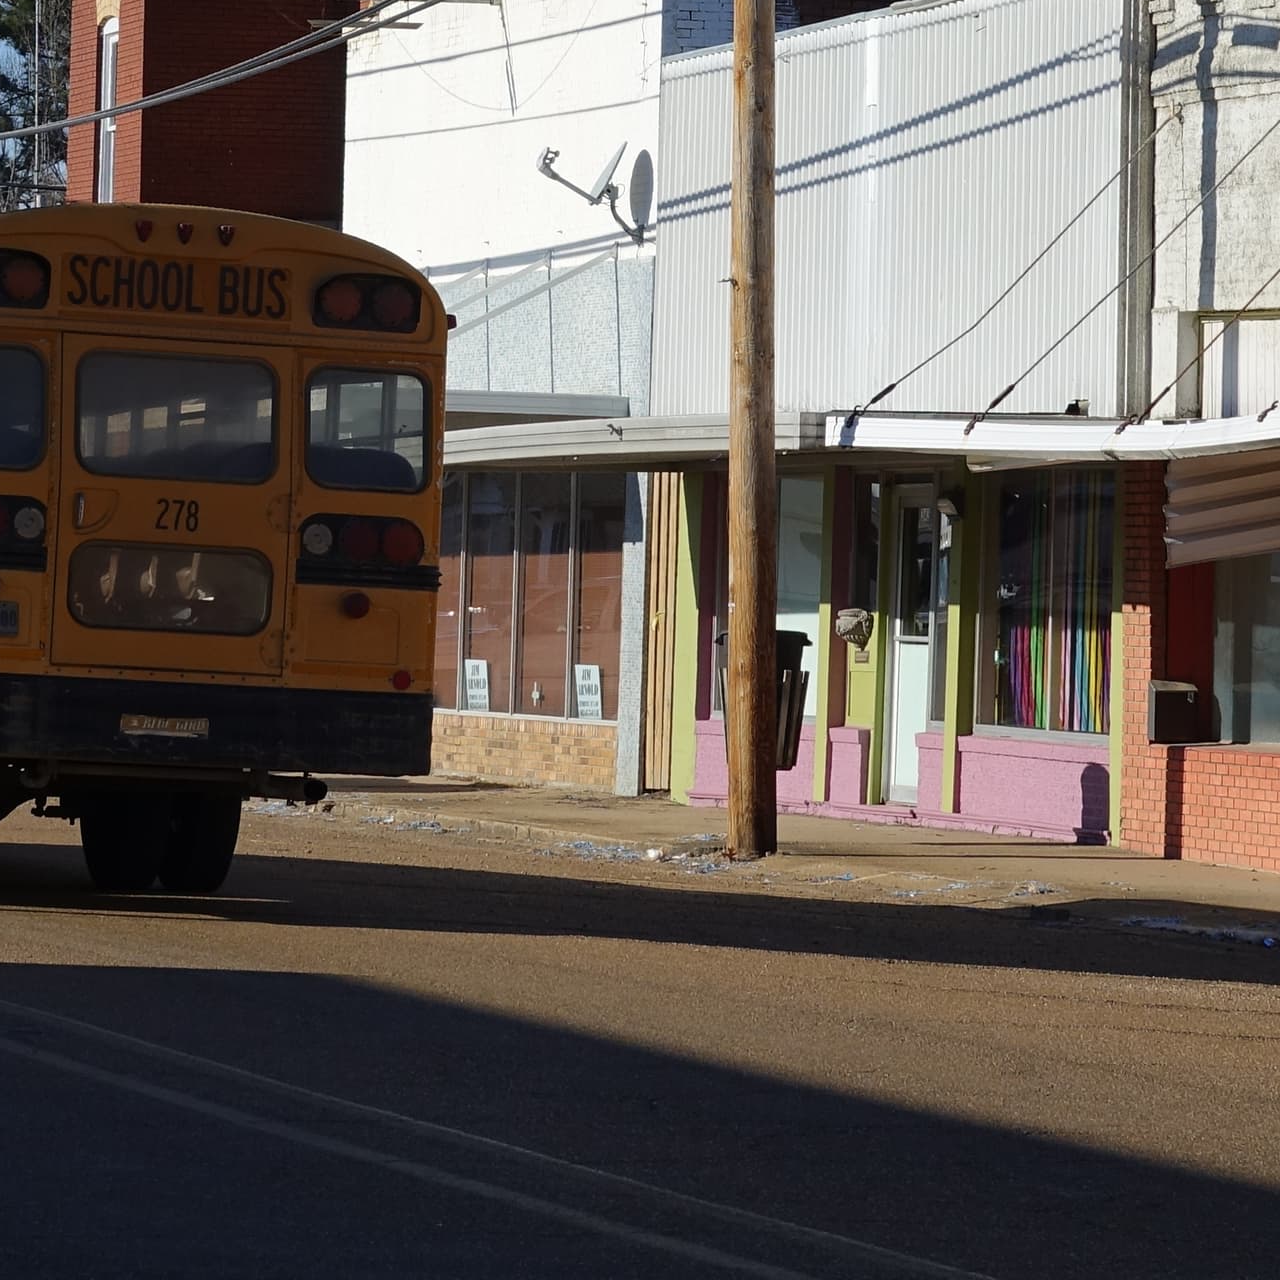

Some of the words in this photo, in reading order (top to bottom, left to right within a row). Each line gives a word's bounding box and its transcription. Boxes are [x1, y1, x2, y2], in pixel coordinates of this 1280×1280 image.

[67, 254, 204, 313] SCHOOL
[217, 265, 288, 319] BUS
[155, 498, 200, 532] 278
